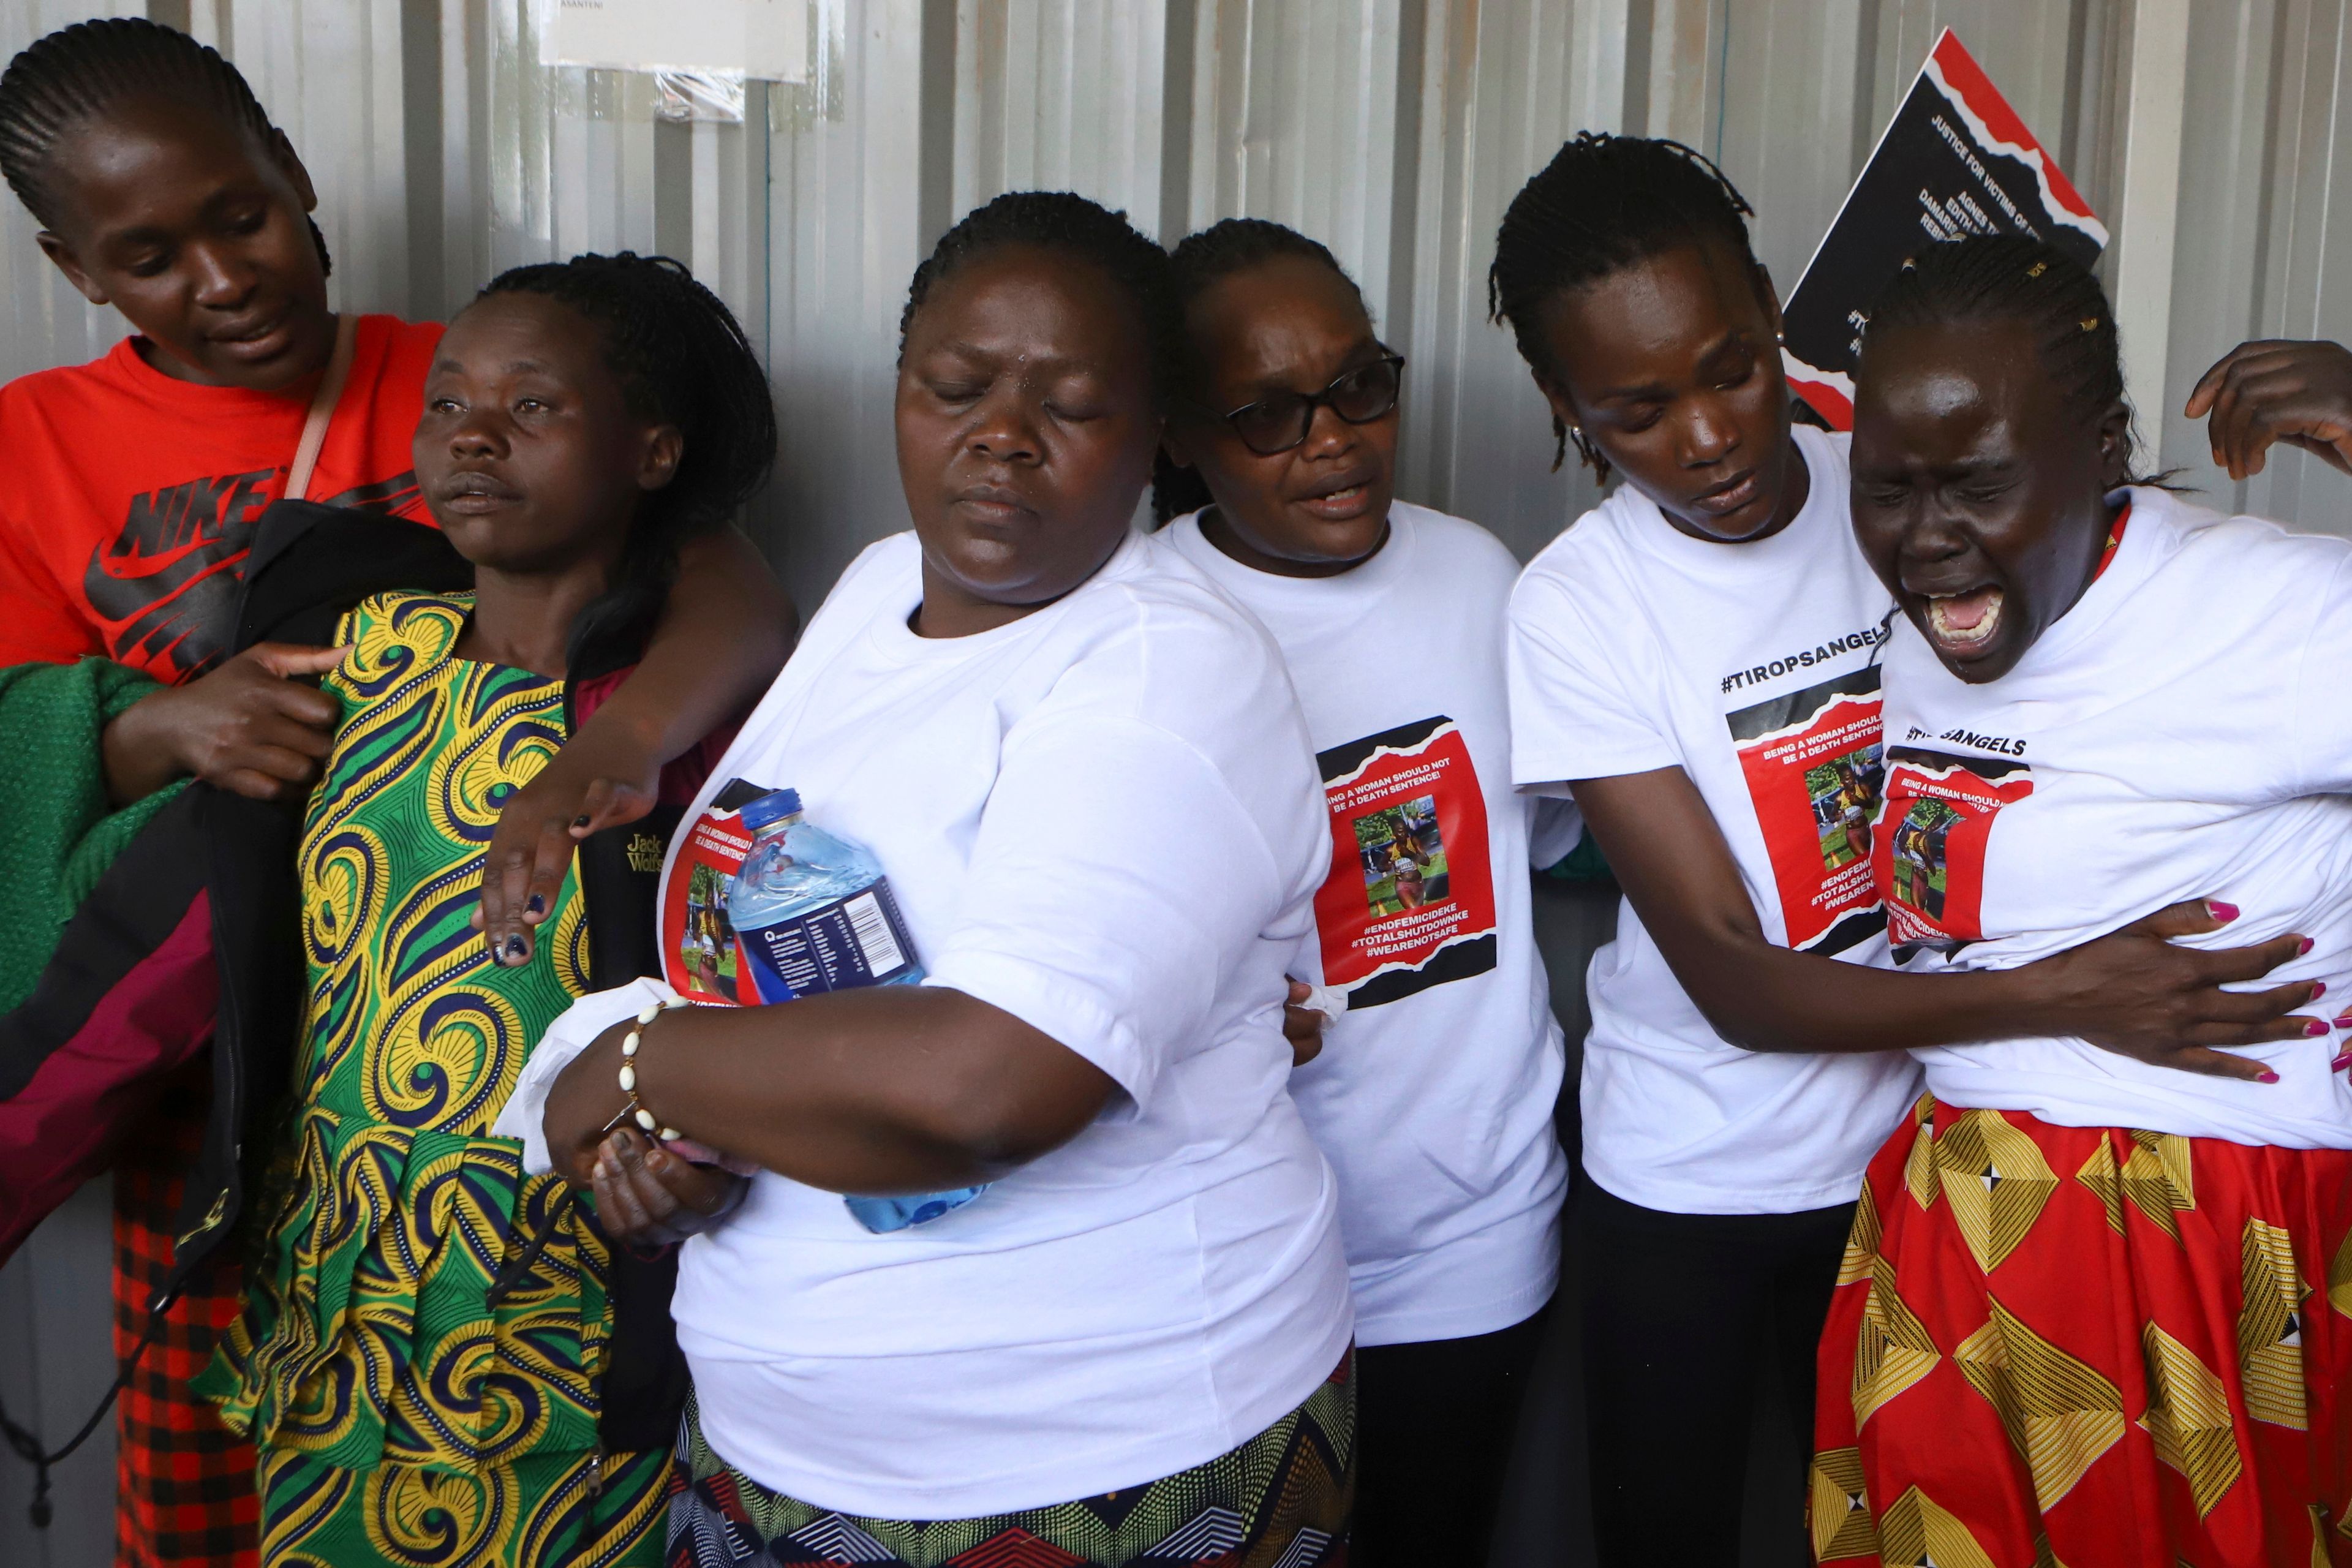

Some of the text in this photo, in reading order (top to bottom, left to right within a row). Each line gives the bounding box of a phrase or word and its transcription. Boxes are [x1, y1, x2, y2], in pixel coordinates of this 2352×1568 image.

[1931, 115, 1969, 160] JUSTICE
[1966, 154, 1986, 181] FOR
[1984, 174, 2017, 218] VICTIMS
[1945, 197, 1973, 232] EDITH
[1958, 190, 1988, 228] AGNES
[108, 467, 276, 559] NIKE
[1721, 627, 1887, 694] #TIROPSANGEL
[1763, 714, 1882, 760] BEING A WOMAN SHOUL
[1782, 755, 1797, 765] BE
[1799, 751, 1807, 760] A
[1807, 739, 1841, 756] DEATH
[1333, 771, 1441, 813] BE A DEATH SENTENCE!
[1348, 790, 1355, 798] A
[1355, 777, 1392, 795] WOMAN
[1392, 764, 1430, 782] SHOULD
[1431, 758, 1450, 770] NOT
[1901, 777, 1921, 790] BEING
[1928, 784, 1961, 800] WOMAN
[1961, 793, 2000, 808] SHOULD
[627, 834, 662, 853] Jack
[703, 838, 722, 853] DEATH
[709, 827, 731, 842] WOMAN
[727, 835, 749, 850] SHOULD
[1825, 880, 1875, 911] #WEAREN
[1351, 910, 1469, 948] #TOTALSHUTDOWNKE
[1363, 902, 1457, 935] #ENDFEMICIDEKE
[1366, 924, 1458, 957] #WEARENOTSAFE
